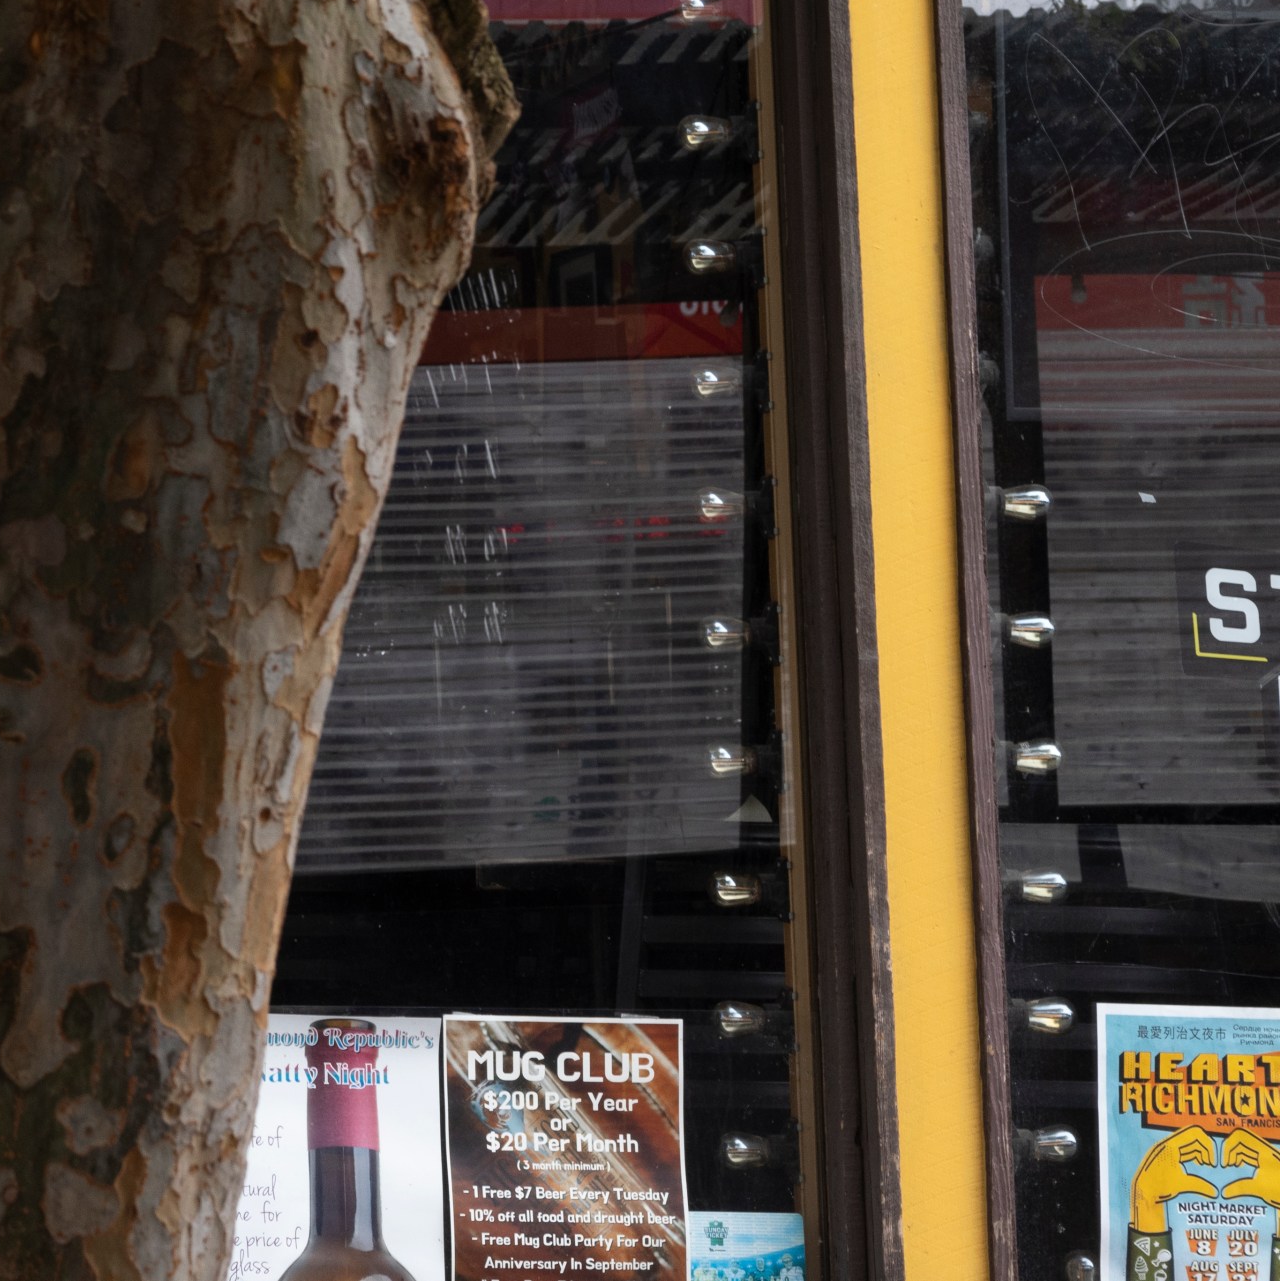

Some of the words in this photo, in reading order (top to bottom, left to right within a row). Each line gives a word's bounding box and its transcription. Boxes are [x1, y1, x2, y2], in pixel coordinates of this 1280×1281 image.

[323, 1027, 434, 1053] Republic's
[1137, 1025, 1227, 1041] 最愛列治文夜市
[260, 1062, 318, 1089] atty
[323, 1062, 389, 1089] Night
[467, 1050, 545, 1081] MUG
[557, 1052, 655, 1083] CLUB
[1119, 1051, 1280, 1086] HEART
[483, 1090, 539, 1112] $200
[545, 1092, 581, 1111] Per
[588, 1092, 638, 1112] Year
[550, 1118, 572, 1131] or
[1216, 1118, 1235, 1127] SAN
[486, 1131, 527, 1153] $20
[534, 1133, 570, 1152] Per
[576, 1133, 639, 1153] Month
[482, 1186, 511, 1199] Free
[515, 1186, 531, 1200] $7
[536, 1187, 566, 1200] Beer
[570, 1188, 610, 1204] Every
[614, 1188, 669, 1205] Tuesday
[469, 1209, 494, 1223] 10%
[498, 1210, 515, 1223] off
[519, 1210, 534, 1223] all
[537, 1210, 564, 1223] food
[567, 1210, 590, 1223] and
[594, 1210, 644, 1227] draught
[648, 1211, 676, 1225] beer
[1178, 1202, 1216, 1213] NIGHT
[1219, 1203, 1267, 1216] MARKET
[1188, 1215, 1254, 1226] SATURDAY
[481, 1232, 511, 1246] Free
[514, 1233, 540, 1249] Mug
[543, 1233, 571, 1247] Club
[575, 1234, 613, 1251] Party
[617, 1234, 638, 1247] For
[642, 1235, 666, 1248] Our
[1189, 1228, 1218, 1240] JUNE
[1230, 1230, 1258, 1240] JULY
[246, 1234, 285, 1257] price
[1197, 1240, 1211, 1256] 8
[1230, 1241, 1258, 1256] 20
[484, 1256, 567, 1274] Anniversary
[571, 1257, 582, 1270] In
[585, 1258, 653, 1273] September
[1191, 1261, 1219, 1272] AUG
[1229, 1262, 1258, 1273] SEPT
